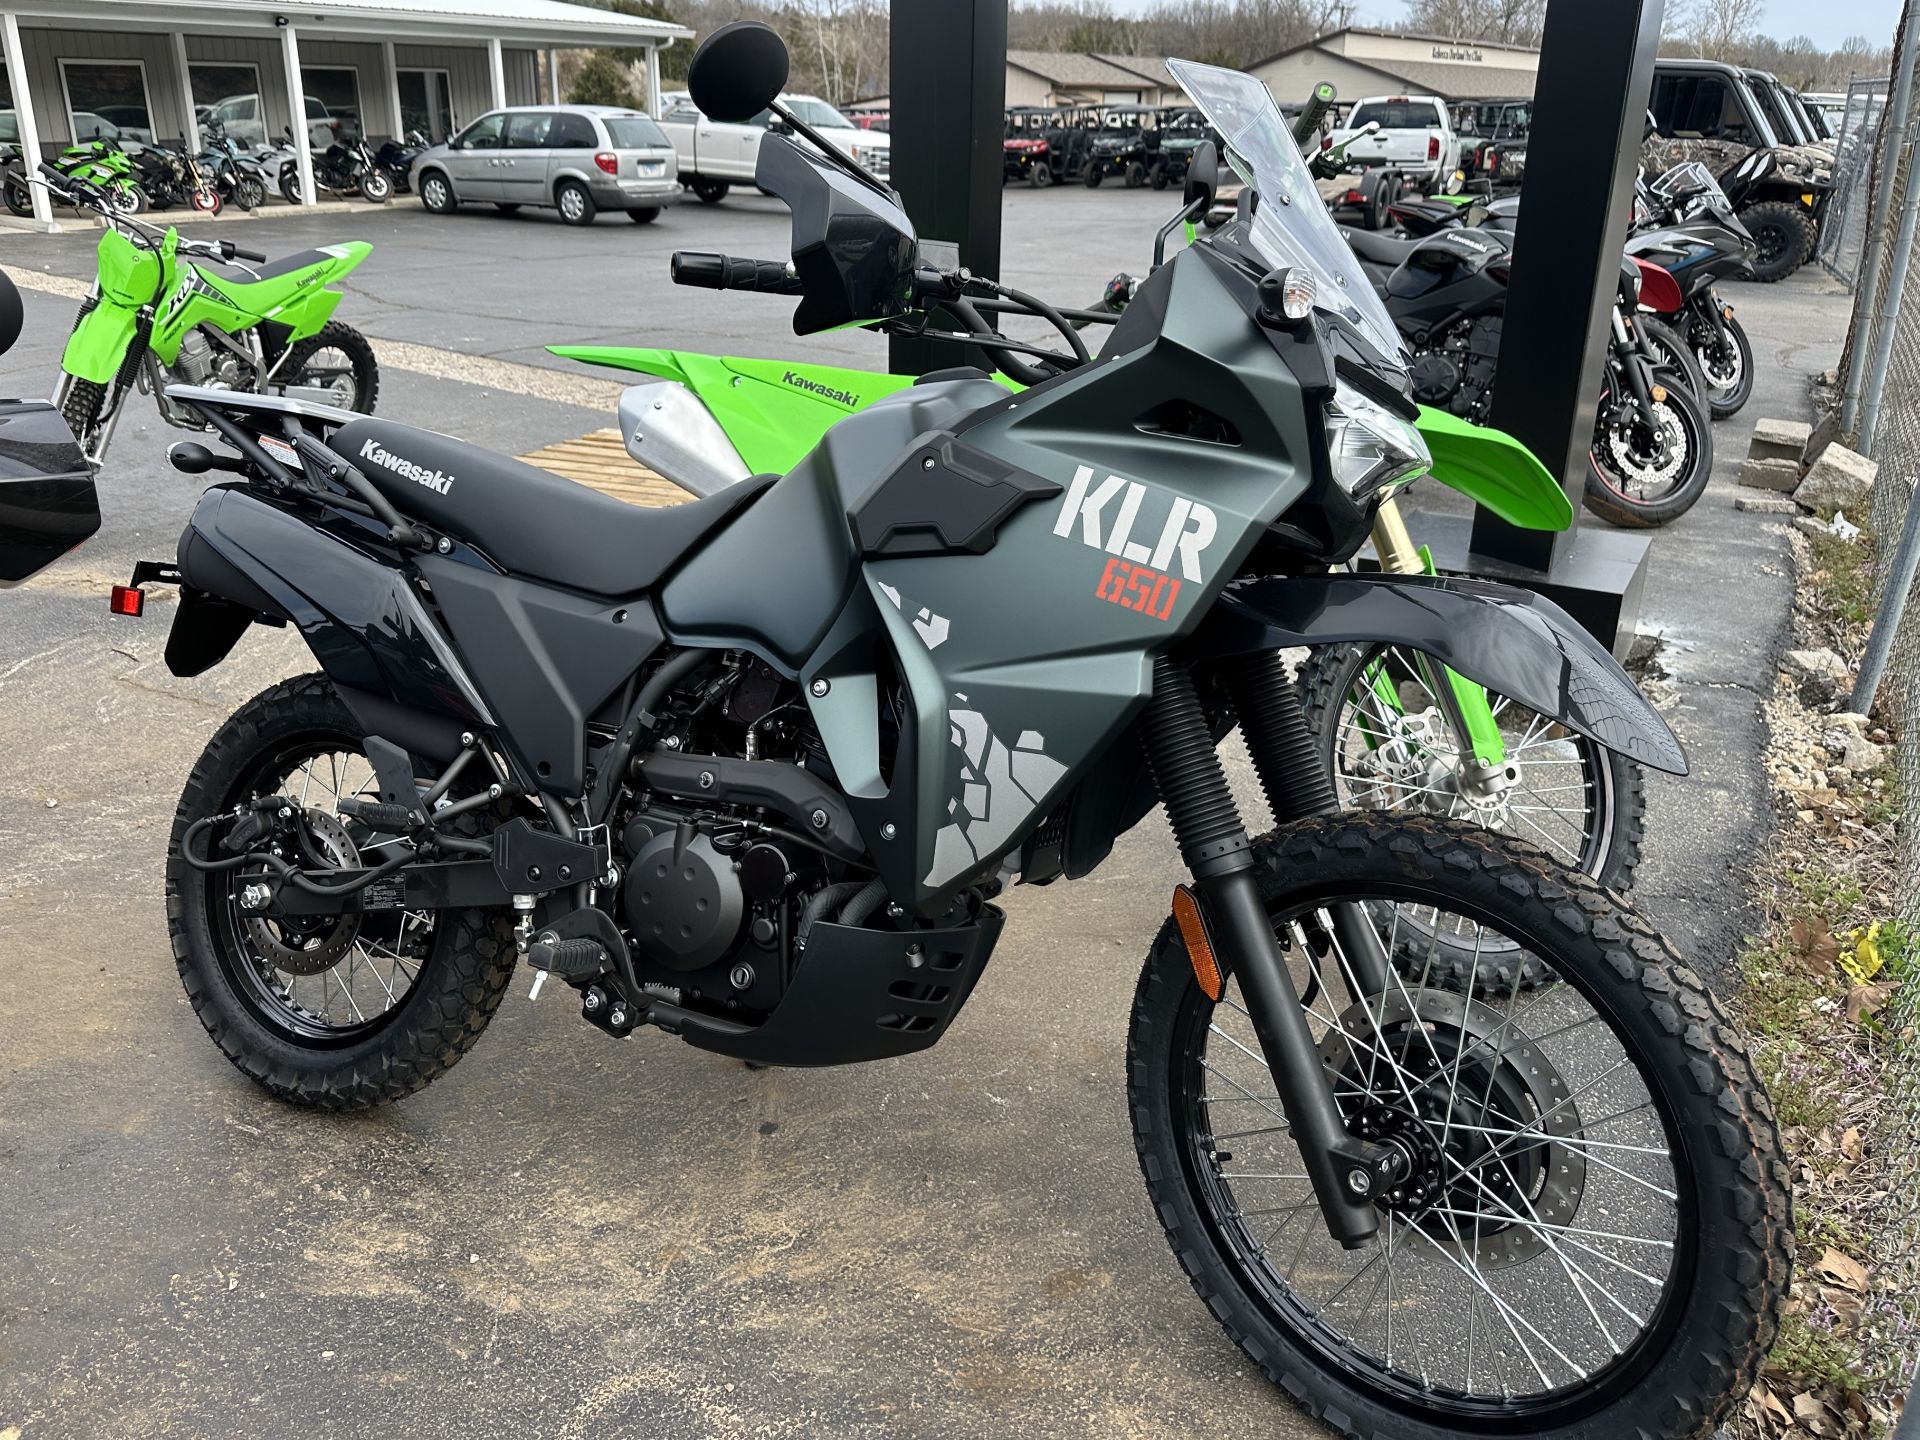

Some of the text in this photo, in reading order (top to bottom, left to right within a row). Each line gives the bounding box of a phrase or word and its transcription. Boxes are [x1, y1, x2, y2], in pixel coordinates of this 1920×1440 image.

[1446, 232, 1488, 253] Kawasaki
[781, 370, 860, 408] Kawasaki
[359, 438, 456, 496] Kawasaki
[1052, 464, 1218, 585] KLR
[1095, 557, 1182, 622] 650
